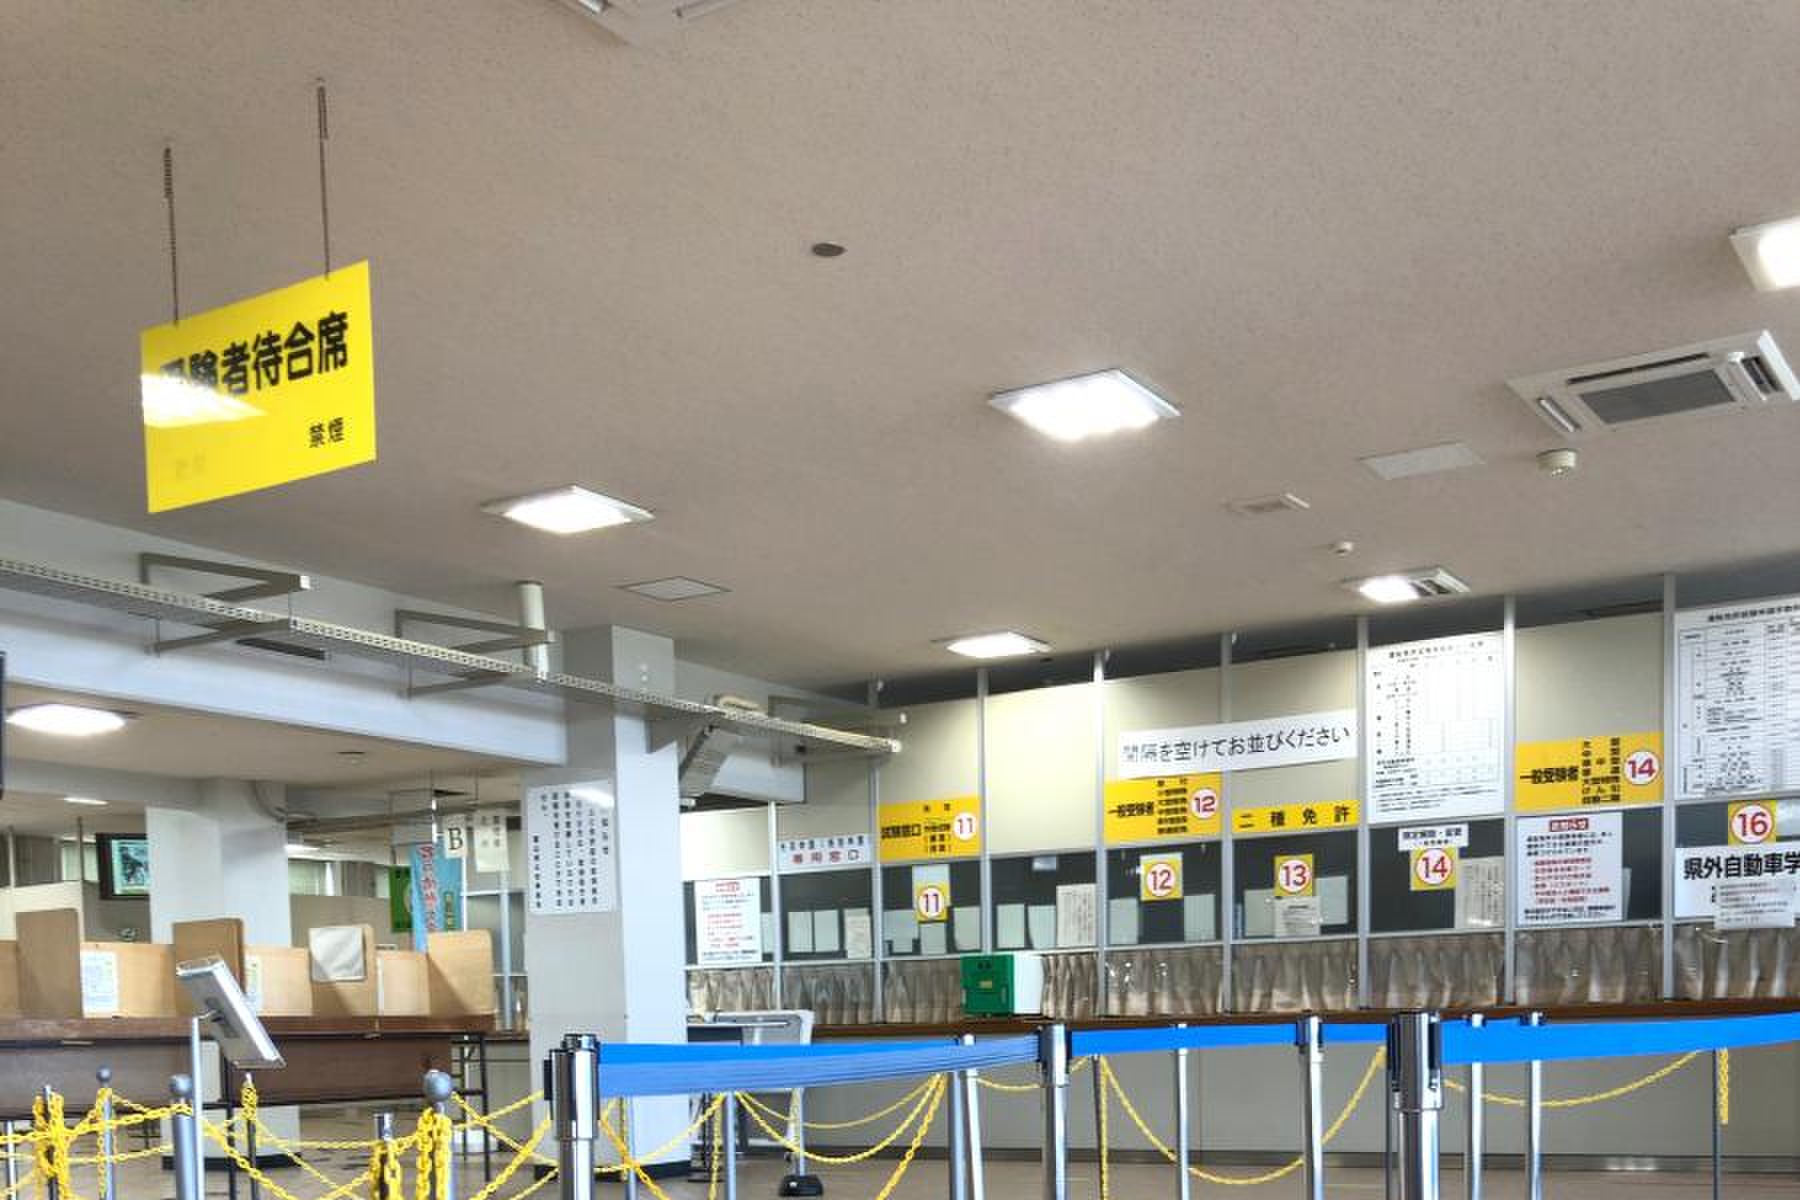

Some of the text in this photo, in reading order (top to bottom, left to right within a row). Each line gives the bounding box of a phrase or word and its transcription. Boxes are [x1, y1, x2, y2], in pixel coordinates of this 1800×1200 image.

[309, 418, 345, 448] 禁煙
[1123, 727, 1351, 764] 間隔を空けてお並びください
[1627, 757, 1657, 779] 14
[1194, 795, 1216, 813] 12
[957, 817, 974, 836] 11
[1239, 805, 1350, 829] 二種免許
[1738, 812, 1768, 837] 16
[448, 827, 464, 850] B
[1283, 864, 1307, 887] 13
[1422, 856, 1448, 878] 14
[1684, 851, 1800, 880] 県外自動車学
[1151, 869, 1172, 890] 12
[923, 893, 941, 913] 11
